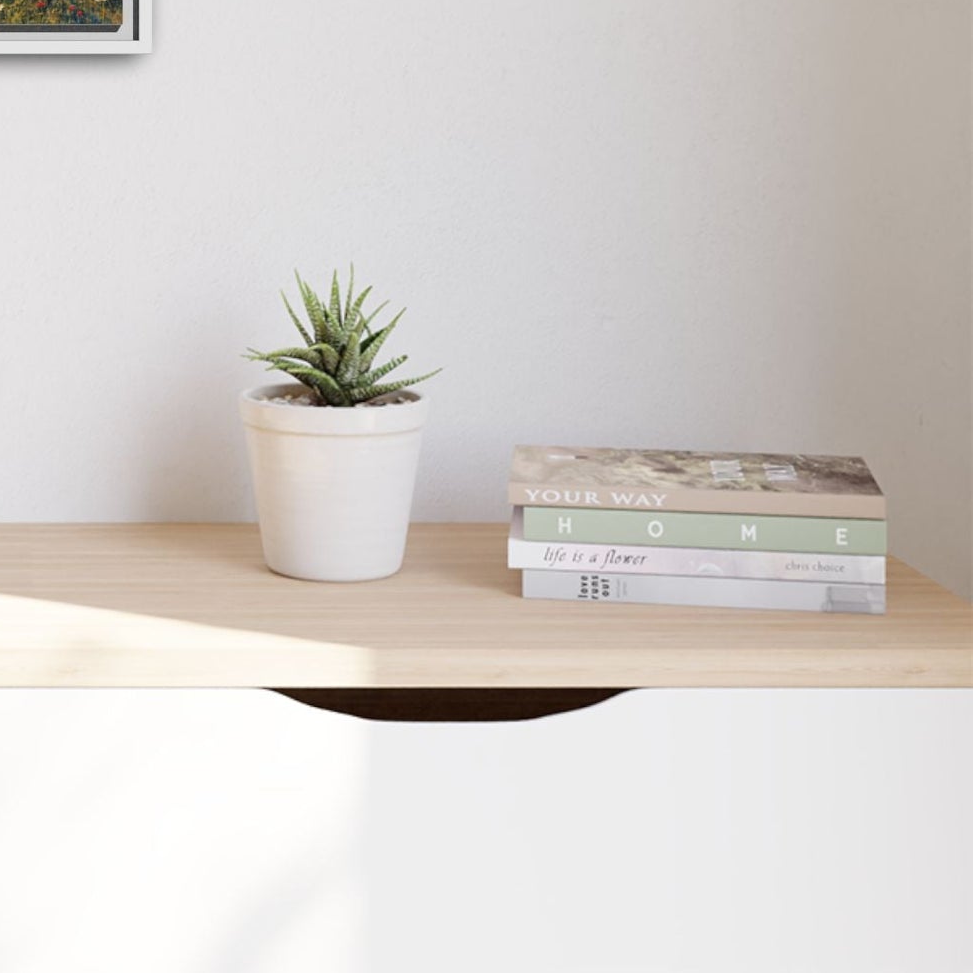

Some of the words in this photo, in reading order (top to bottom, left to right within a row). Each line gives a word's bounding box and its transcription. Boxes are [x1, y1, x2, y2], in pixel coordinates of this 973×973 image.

[525, 489, 601, 504] YOUR
[610, 492, 667, 506] WAY
[543, 546, 567, 567] life
[572, 549, 584, 563] is
[589, 553, 599, 563] a
[600, 548, 648, 569] flower
[785, 560, 810, 572] chris
[812, 560, 845, 573] choice
[577, 575, 588, 598] love
[590, 575, 599, 599] runs
[600, 579, 610, 597] out
